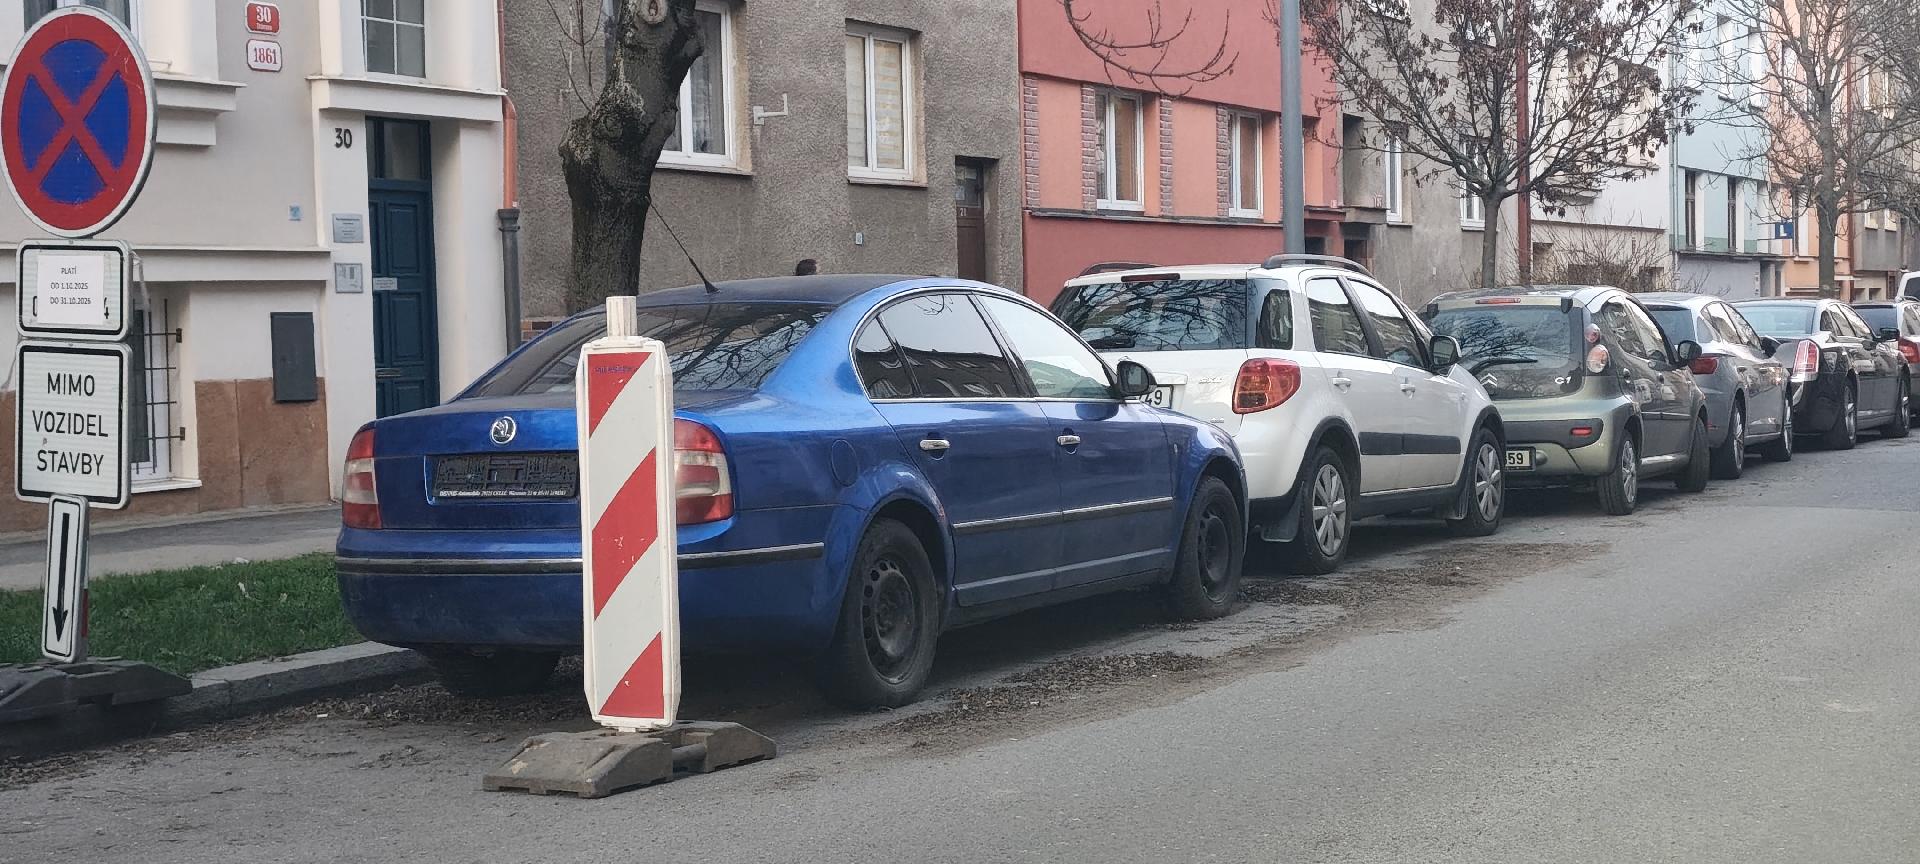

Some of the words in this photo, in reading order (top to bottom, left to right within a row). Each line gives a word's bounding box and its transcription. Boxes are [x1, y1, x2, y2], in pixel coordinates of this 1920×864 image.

[256, 5, 272, 23] 30
[254, 46, 278, 65] 1861
[334, 127, 353, 149] 30
[60, 265, 77, 275] PLATÍ
[50, 282, 60, 290] OD
[49, 296, 60, 305] DO
[47, 372, 95, 397] MIMO
[1554, 376, 1572, 385] C1
[1140, 389, 1163, 405] 49
[32, 409, 109, 438] VOZIDEL
[36, 449, 105, 476] STAVBY
[1504, 452, 1524, 465] 59
